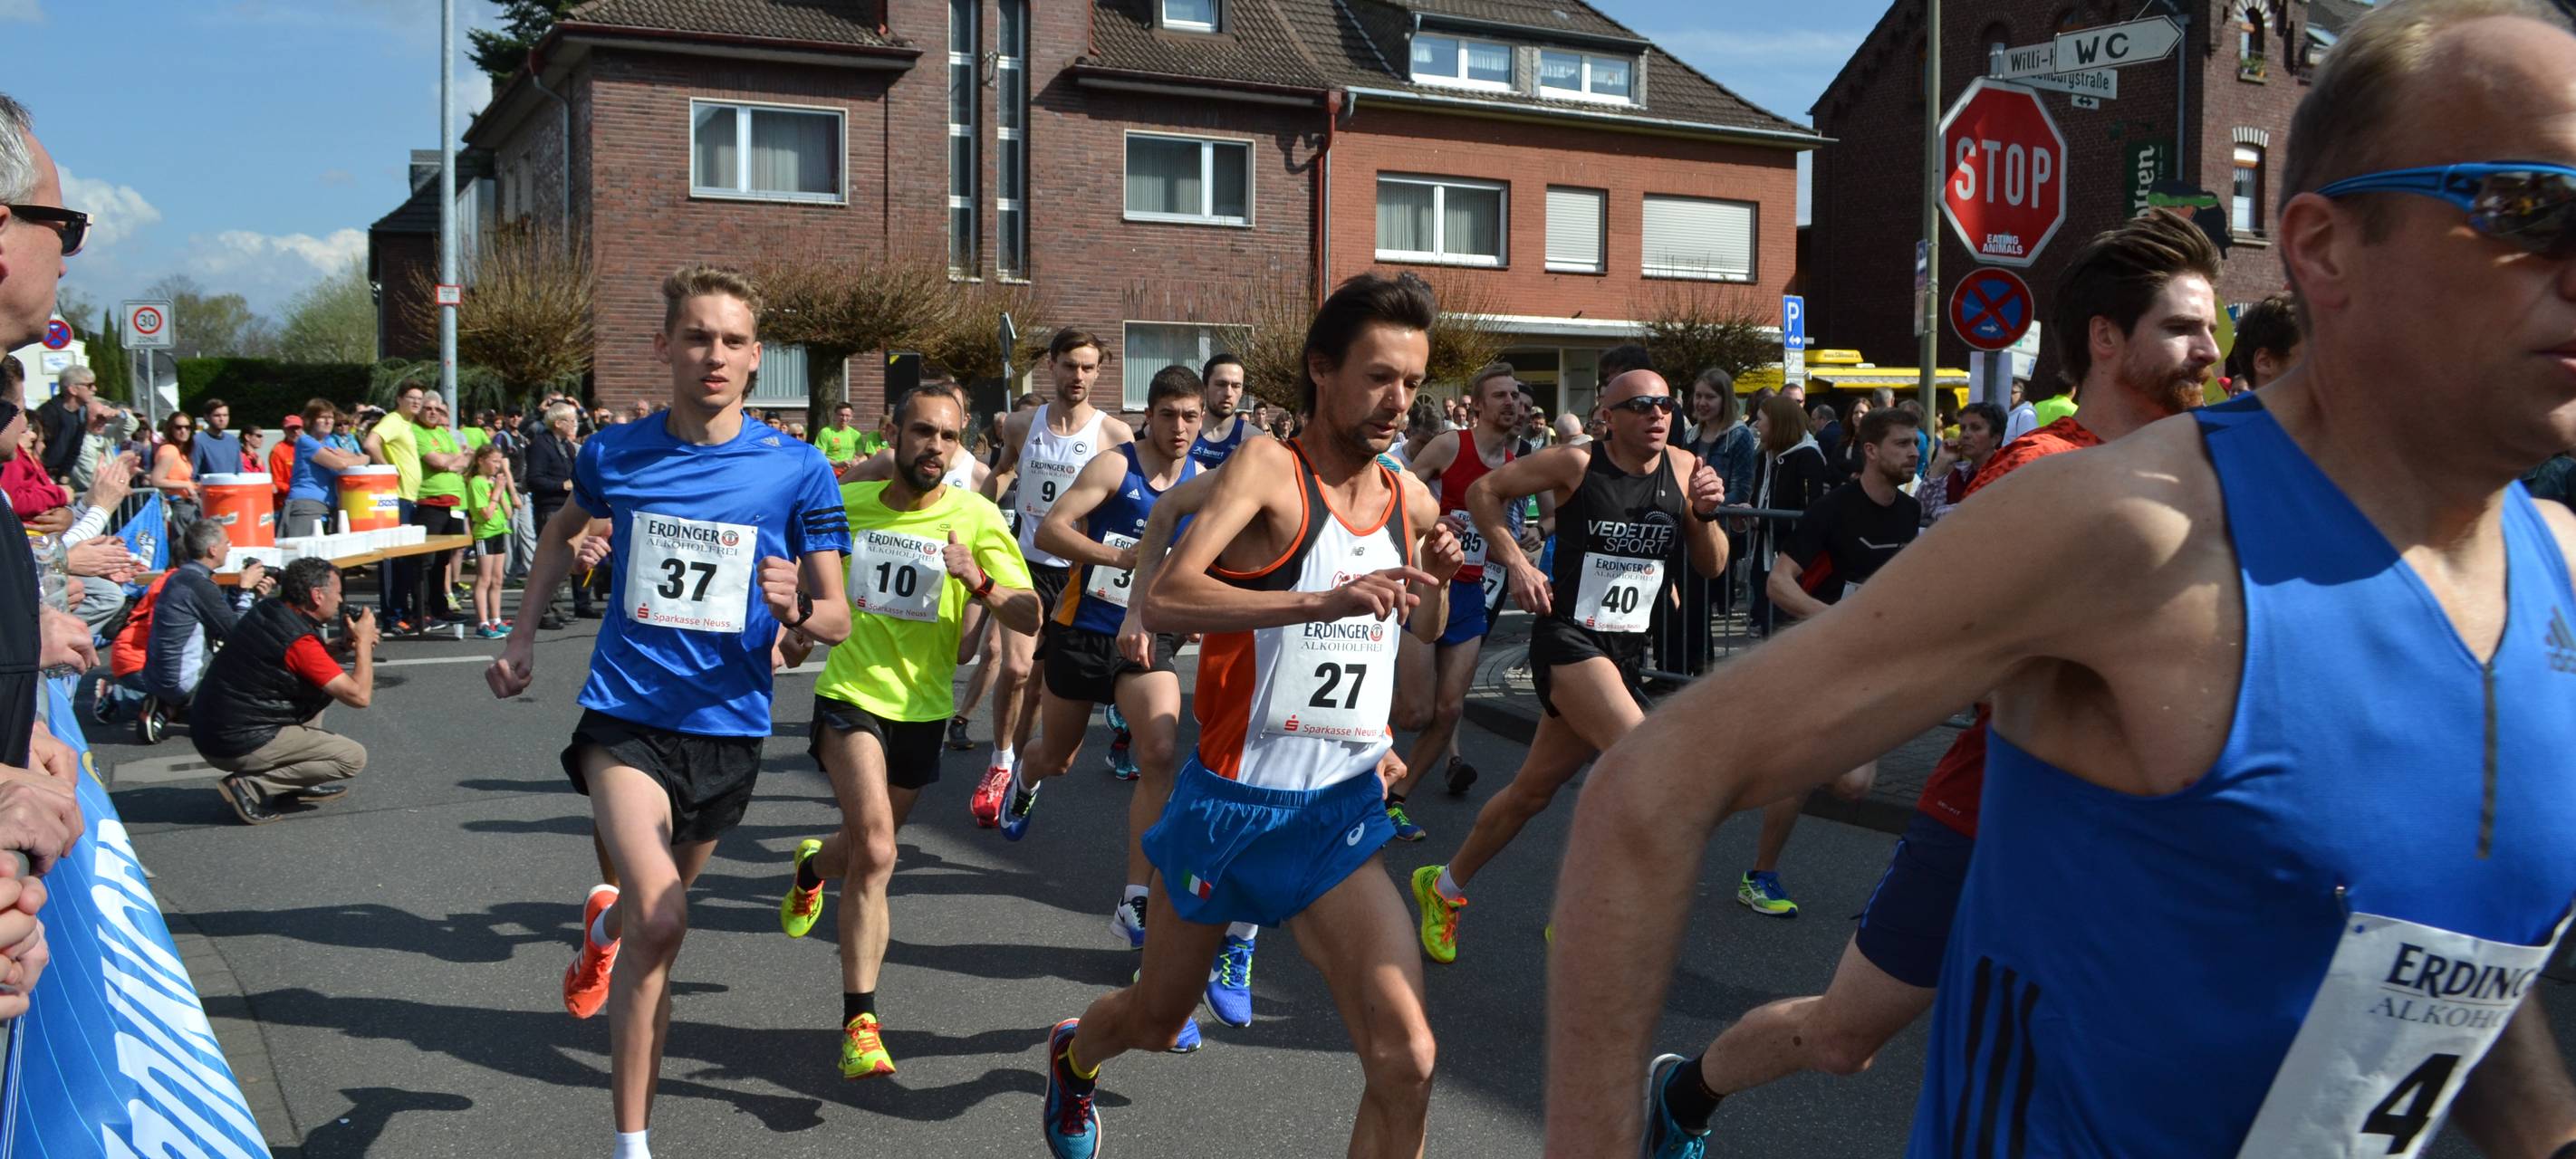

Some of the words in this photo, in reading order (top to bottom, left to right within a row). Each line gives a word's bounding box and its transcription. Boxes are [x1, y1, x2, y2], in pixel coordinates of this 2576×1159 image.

[2075, 33, 2129, 65] WC
[1955, 136, 2052, 209] STOP
[1982, 243, 2023, 254] ANIMALS
[1986, 233, 2019, 244] EATING
[138, 314, 157, 327] 30
[1030, 460, 1065, 473] ERDINGER
[1042, 480, 1056, 503] 9
[649, 520, 721, 545] ERDINGER
[1587, 519, 1673, 540] VEDETTE
[646, 538, 738, 558] ALKOHOLFREI
[868, 532, 922, 553] ERDINGER
[1603, 537, 1668, 554] SPORT
[1595, 558, 1644, 574] ERDINGER
[657, 557, 717, 602] 37
[876, 560, 918, 598] 10
[1600, 585, 1639, 615] 40
[653, 612, 700, 624] Sparkasse
[703, 618, 731, 627] Neuss
[1302, 622, 1370, 641] ERDINGER
[1301, 641, 1383, 653] ALKOHOLFREI
[1308, 661, 1368, 710] 27
[1302, 724, 1352, 736] Sparkasse
[1354, 727, 1378, 737] Neuss
[2361, 1052, 2463, 1156] 4
